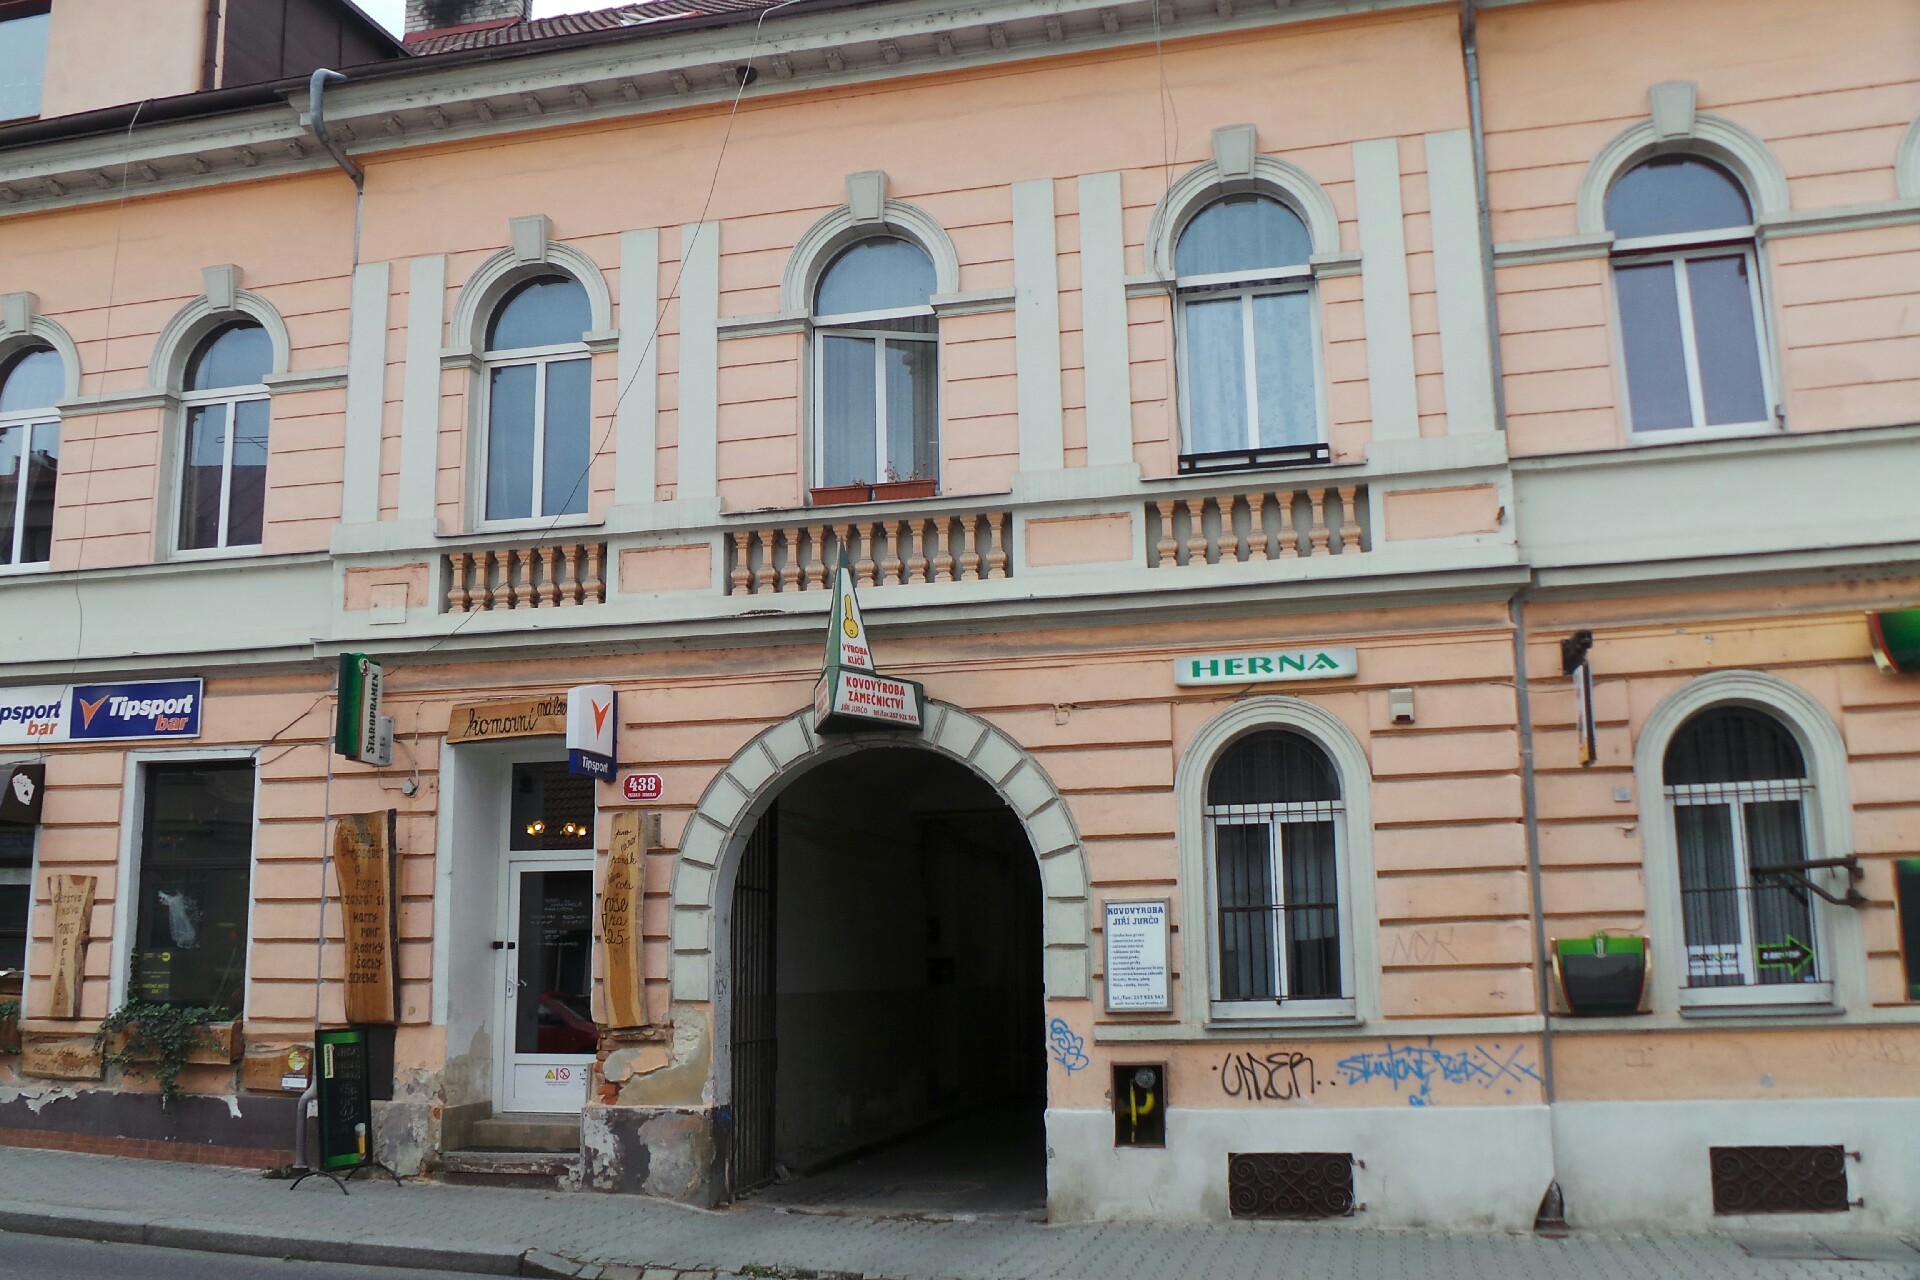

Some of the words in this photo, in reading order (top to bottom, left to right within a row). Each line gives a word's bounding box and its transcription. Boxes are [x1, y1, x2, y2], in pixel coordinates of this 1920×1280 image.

[842, 643, 868, 656] VÝROBA
[1192, 653, 1339, 677] HERNA
[846, 675, 906, 697] KOVOVÝROBA
[109, 695, 193, 720] Tipsport
[848, 689, 904, 710] ZÁMEČNICTVÍ
[0, 700, 61, 725] psport
[27, 720, 58, 735] bar
[155, 715, 189, 731] bar
[463, 708, 538, 737] komorní
[582, 756, 609, 774] Tipsport
[629, 777, 656, 791] 438
[1107, 905, 1164, 915] KOVOVÝROBA
[1113, 916, 1130, 926] JIŘÍ
[1132, 915, 1159, 925] JURČO
